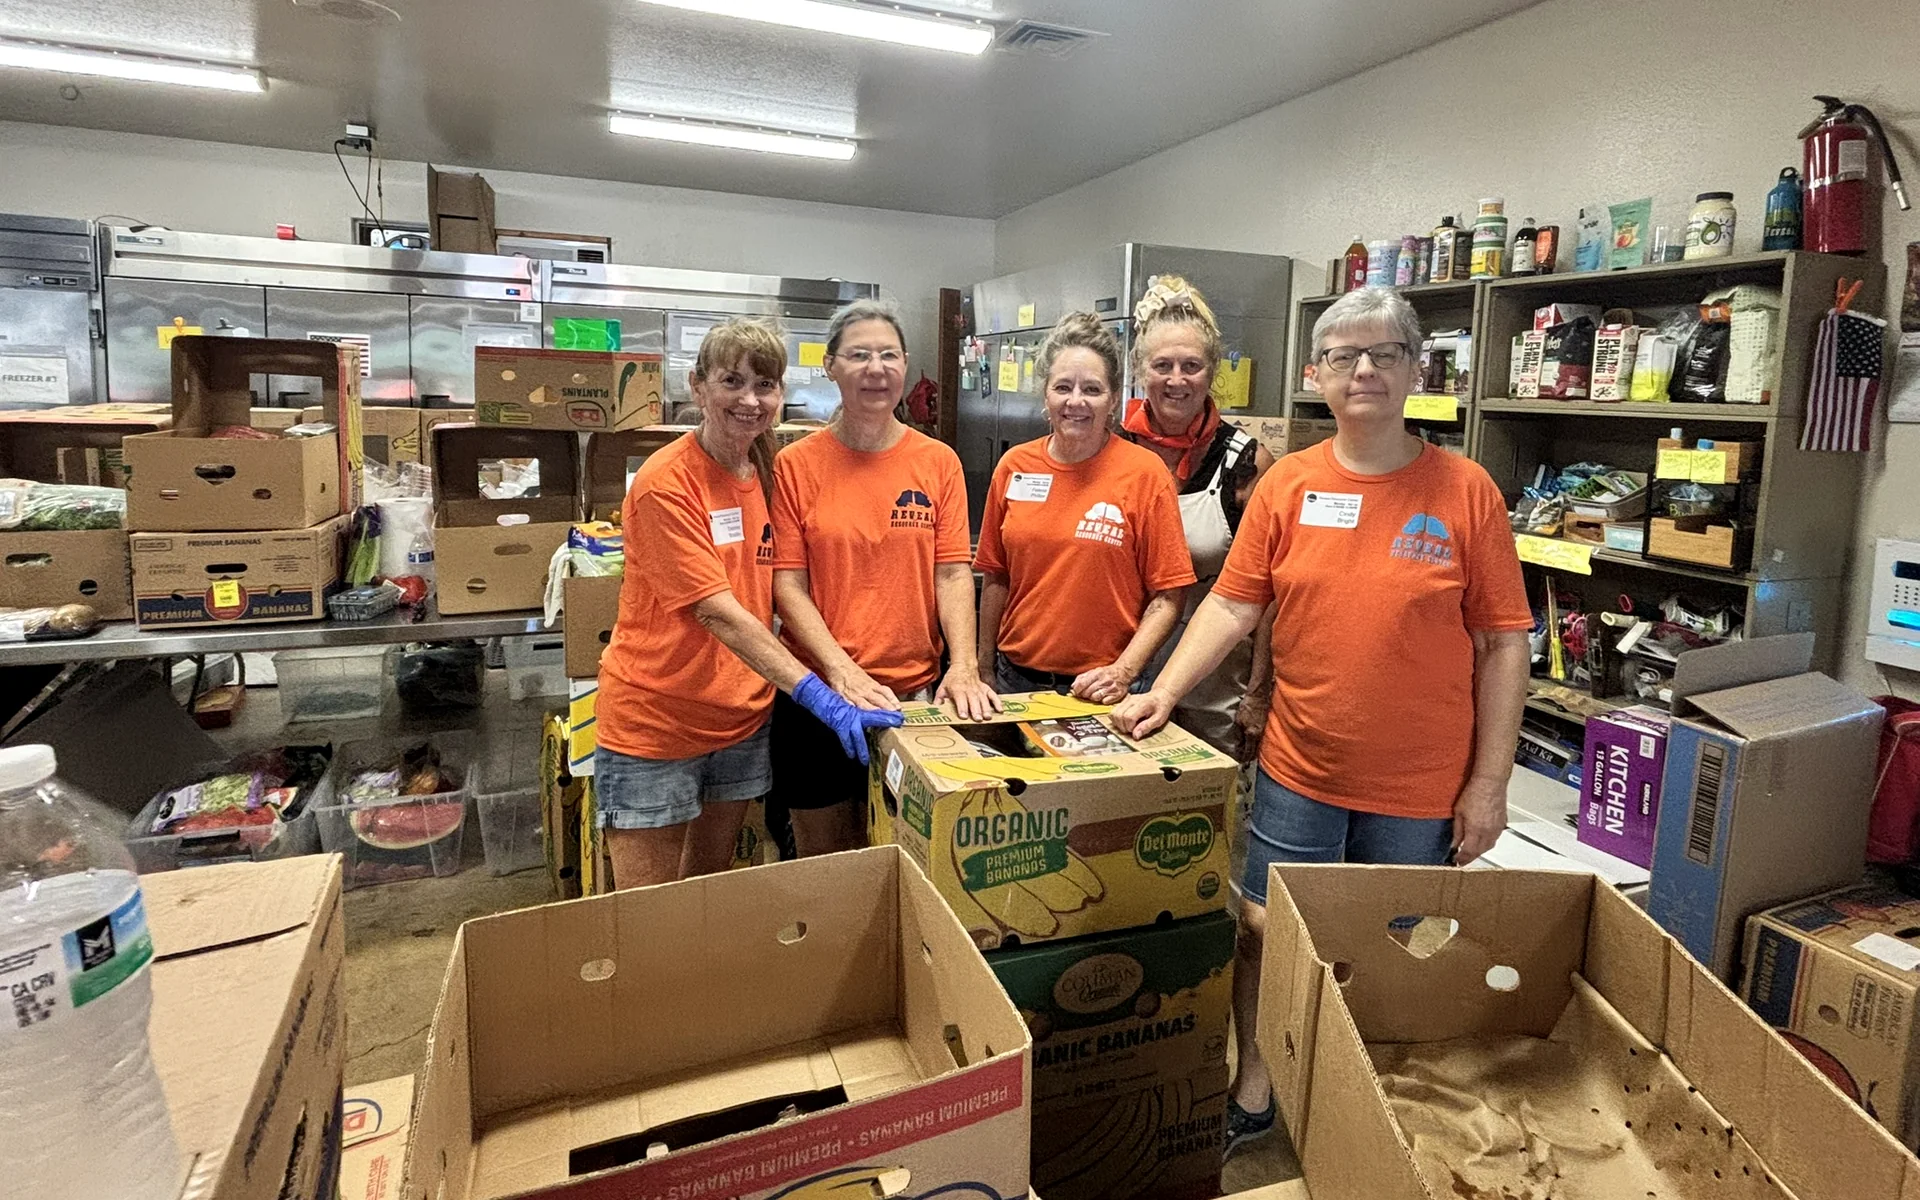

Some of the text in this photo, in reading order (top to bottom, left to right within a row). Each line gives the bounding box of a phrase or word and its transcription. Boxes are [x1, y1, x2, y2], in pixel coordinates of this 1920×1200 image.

[1521, 342, 1533, 374] STRONG
[1595, 339, 1608, 374] STRONG
[2, 374, 44, 382] FREEZER
[562, 387, 609, 398] PLANTAINS
[1337, 517, 1355, 525] Bright
[1338, 510, 1356, 518] Cindy
[1076, 520, 1125, 539] REVEAL
[188, 538, 262, 547] PREMIUM BANANAS
[1391, 536, 1453, 559] REVEAL
[143, 603, 309, 620] PREMIUM BANANAS
[1139, 744, 1205, 760] ORGANIC
[1538, 748, 1553, 763] Kit
[904, 765, 934, 817] ORGANIC
[1588, 750, 1605, 826] 13 GALLON Bags
[1605, 744, 1630, 836] KITCHEN
[956, 807, 1069, 848] ORGANIC
[1142, 828, 1210, 852] Del Monte
[986, 845, 1045, 870] PREMIUM
[985, 859, 1047, 884] BANANAS
[11, 982, 29, 997] CA
[1097, 1013, 1196, 1053] BANANAS
[940, 1085, 1008, 1123] PREMIUM
[859, 1108, 934, 1147] BANANAS
[1158, 1113, 1222, 1142] PREMIUM
[760, 1138, 841, 1177] PREMIUM
[1158, 1130, 1222, 1160] BANANAS
[667, 1162, 756, 1199] BANANAS
